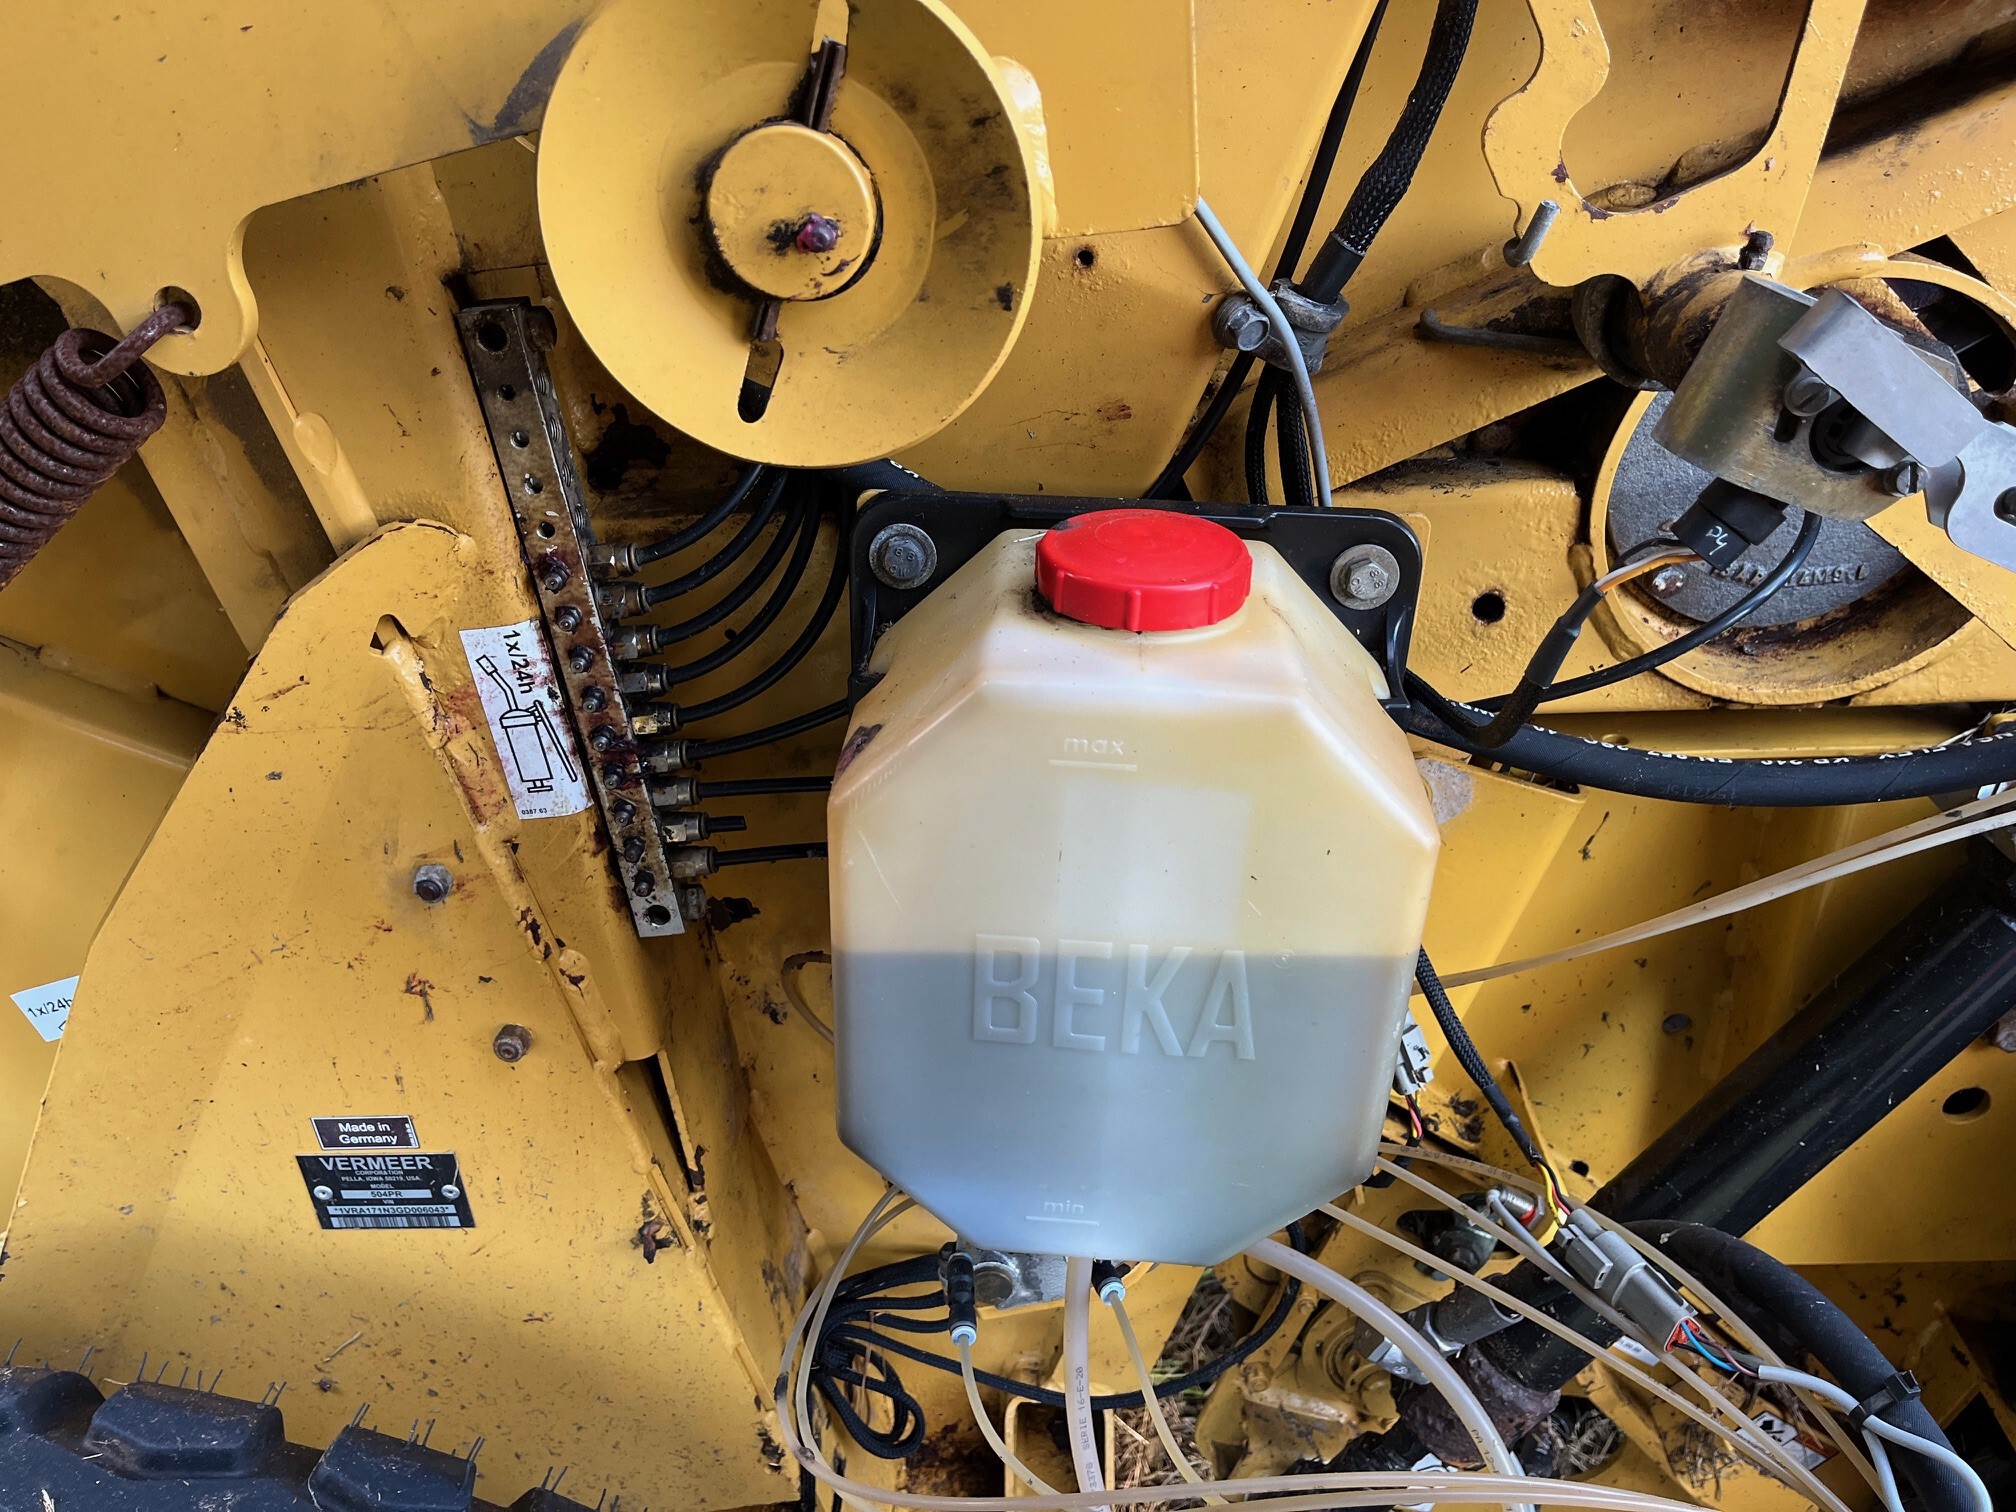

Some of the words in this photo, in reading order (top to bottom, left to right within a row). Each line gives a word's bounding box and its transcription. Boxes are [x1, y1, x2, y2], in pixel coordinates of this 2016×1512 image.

[503, 630, 534, 694] 1x/24h
[1063, 738, 1124, 755] max
[972, 933, 1256, 1060] BEKA
[338, 1123, 376, 1133] Made
[377, 1122, 390, 1132] in
[339, 1134, 397, 1145] Germany
[318, 1156, 434, 1171] VERMEER
[1044, 1200, 1084, 1214] min
[1079, 1417, 1091, 1450] SERIE
